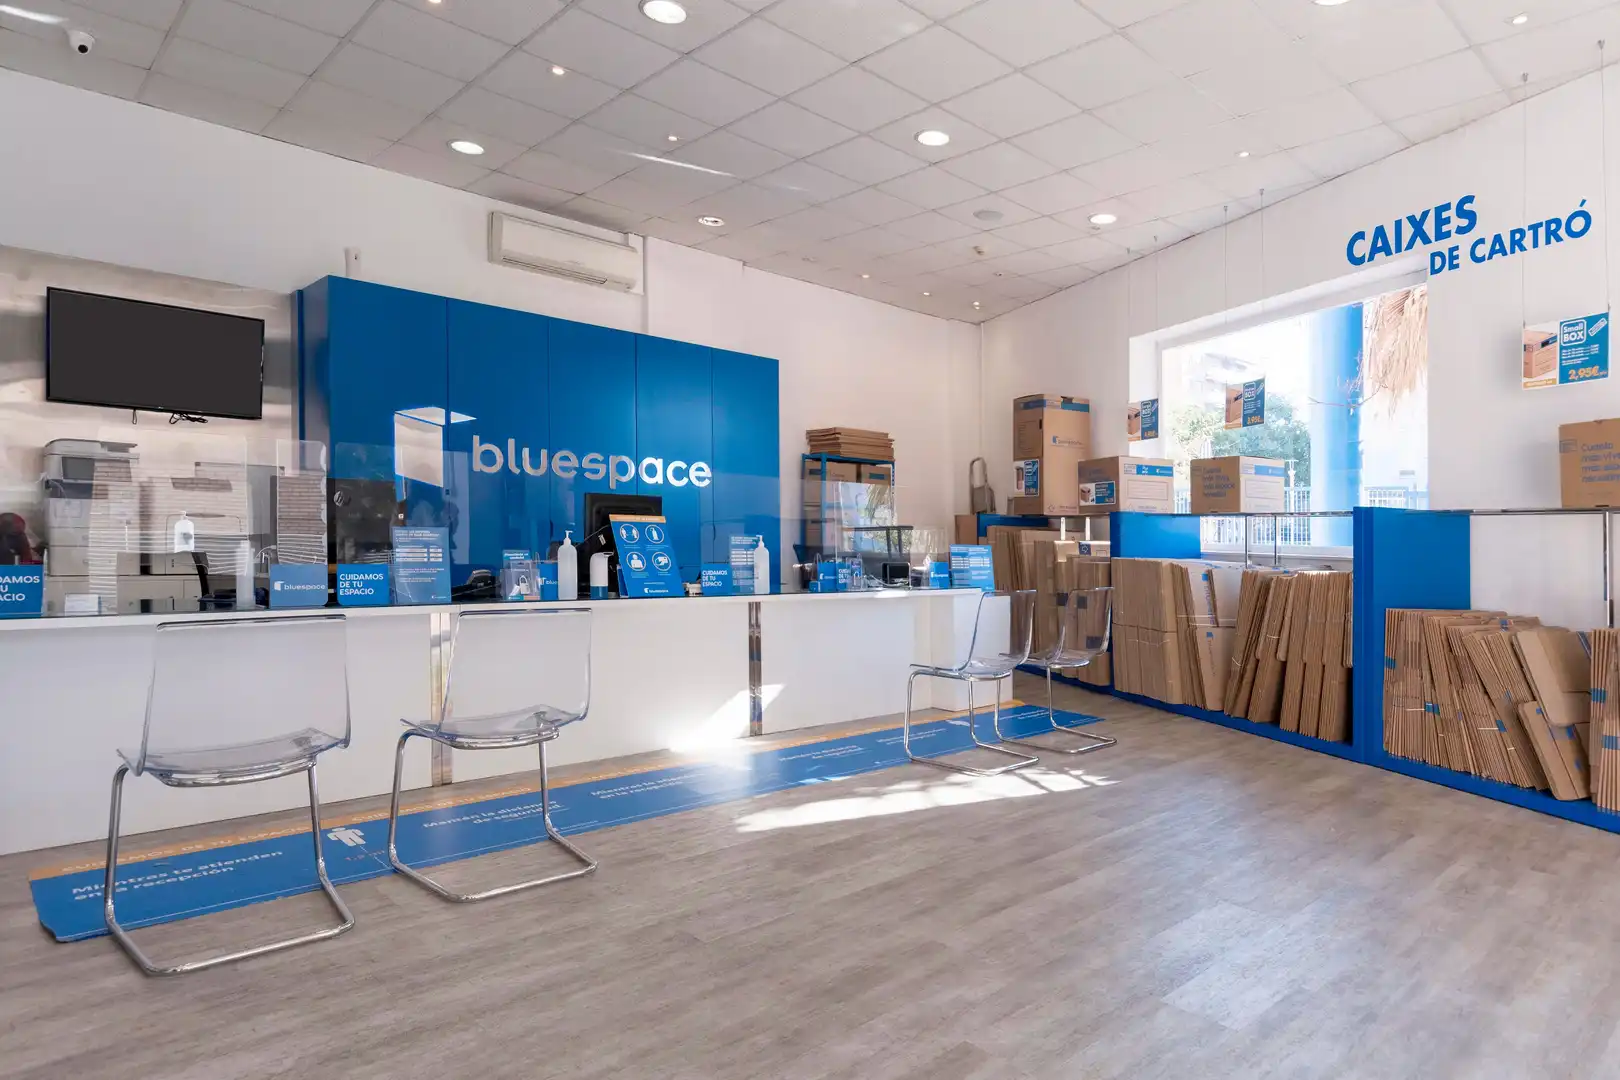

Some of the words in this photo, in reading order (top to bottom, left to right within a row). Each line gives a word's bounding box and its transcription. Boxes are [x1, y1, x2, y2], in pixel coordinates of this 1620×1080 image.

[1346, 195, 1478, 266] CAIXES
[1429, 245, 1460, 276] DE
[1469, 199, 1592, 264] CARTRÓ
[1563, 322, 1584, 333] Small
[1563, 331, 1584, 342] BOX
[472, 435, 712, 489] bluespace
[339, 573, 384, 581] CUIDAMOS
[0, 584, 9, 593] U
[283, 583, 326, 592] bluespace
[497, 800, 557, 814] distanca
[171, 867, 193, 876] te
[198, 851, 283, 871] atienden
[74, 891, 102, 901] en
[132, 865, 234, 889] recepción
